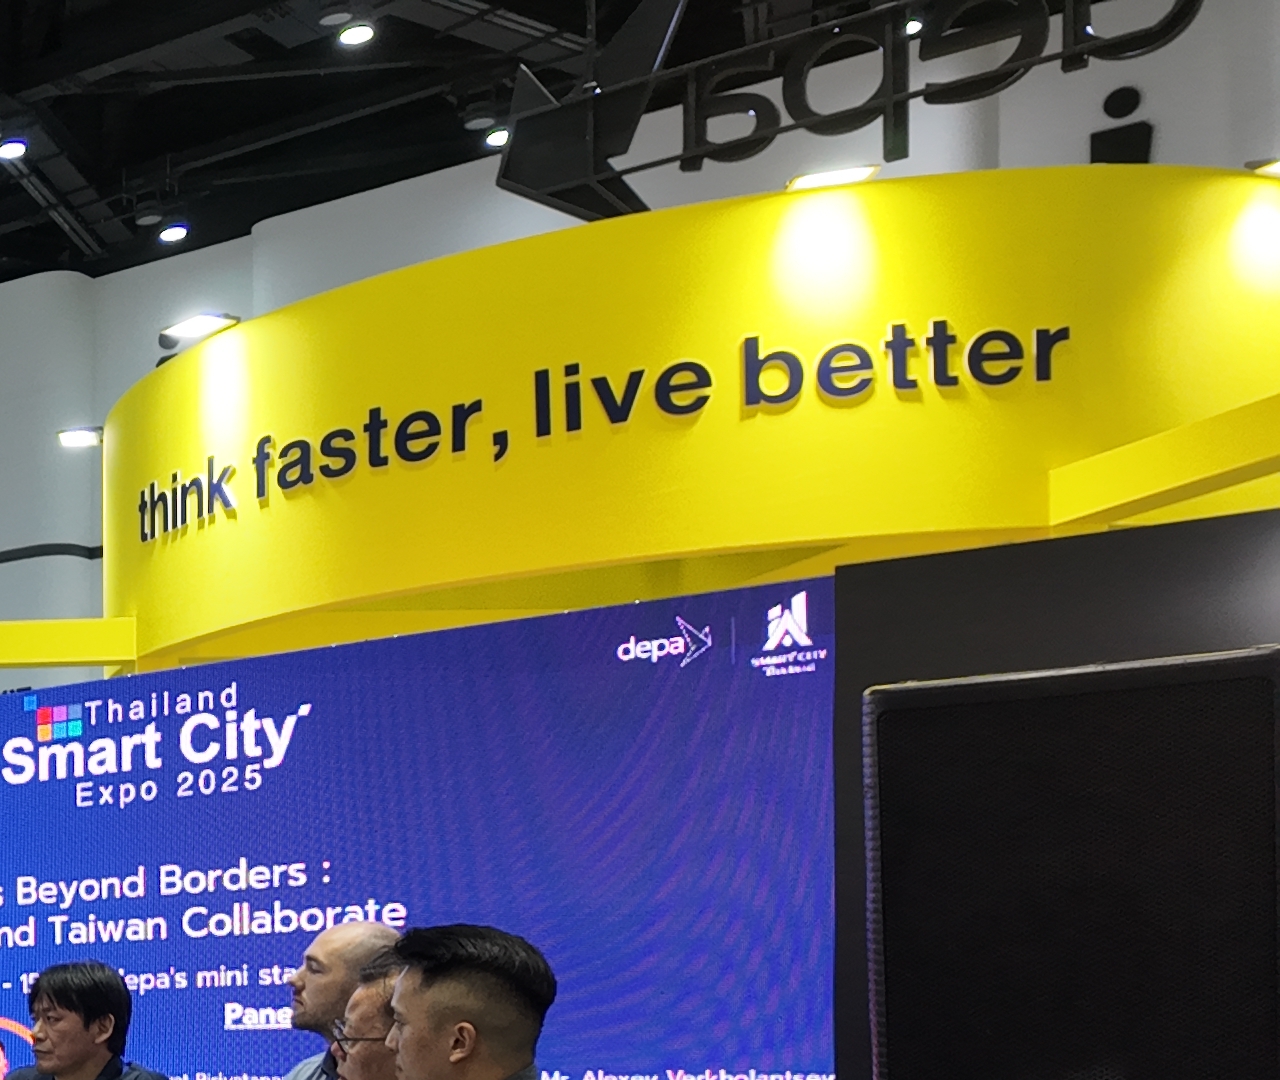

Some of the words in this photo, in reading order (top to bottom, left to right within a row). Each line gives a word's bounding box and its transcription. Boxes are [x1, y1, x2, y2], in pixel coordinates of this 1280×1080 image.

[138, 455, 235, 544] think
[252, 398, 509, 501] faster,
[534, 359, 713, 439] live
[743, 320, 1070, 407] better
[616, 635, 685, 662] depa
[84, 682, 237, 725] Thailand
[1, 721, 162, 786] Smart
[179, 704, 312, 770] City
[75, 780, 158, 809] Expo
[176, 765, 263, 798] 2025
[16, 866, 146, 909] Beyond
[159, 857, 308, 896] Borders
[47, 913, 168, 945] Taiwan
[181, 897, 407, 939] Collaborate
[119, 966, 188, 996] epa's
[196, 964, 249, 988] mini
[258, 962, 292, 986] sta
[223, 1001, 293, 1026] Pane
